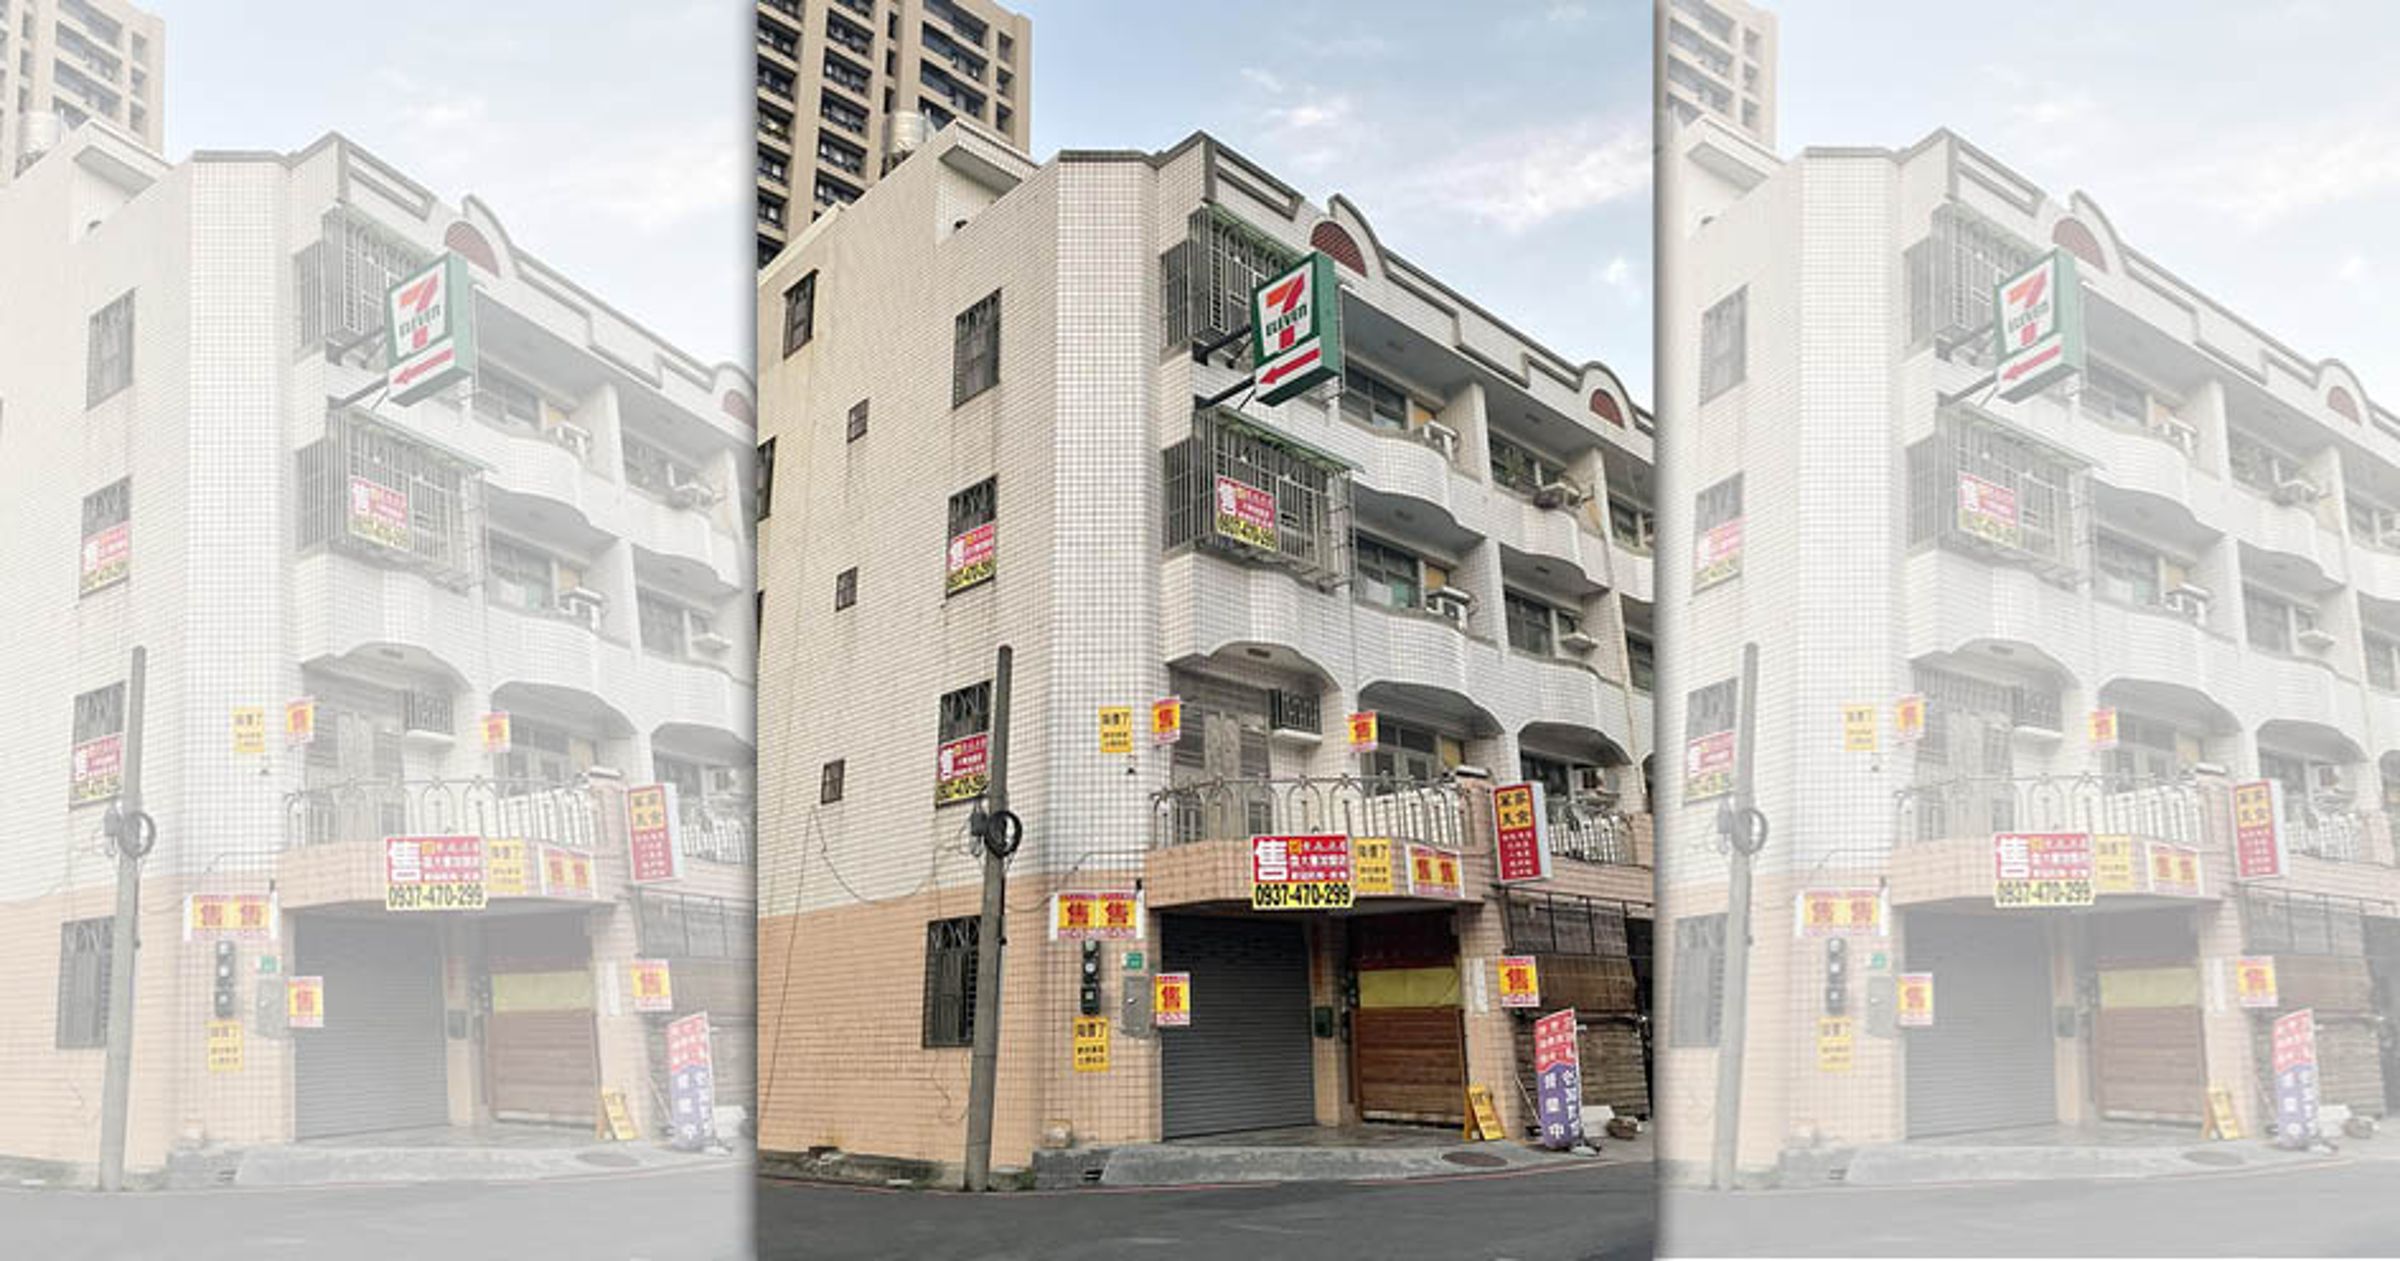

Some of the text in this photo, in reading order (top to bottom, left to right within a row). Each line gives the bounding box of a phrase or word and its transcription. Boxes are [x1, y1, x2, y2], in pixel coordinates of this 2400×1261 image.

[1266, 273, 1305, 350] 7
[388, 841, 421, 882] 售
[1255, 840, 1288, 881] 售
[1997, 838, 2030, 879] 售
[388, 884, 483, 907] 0937-470-299
[1255, 883, 1350, 906] 0937-470-299
[1067, 902, 1129, 925] 售 售
[1161, 985, 1182, 1010] 售
